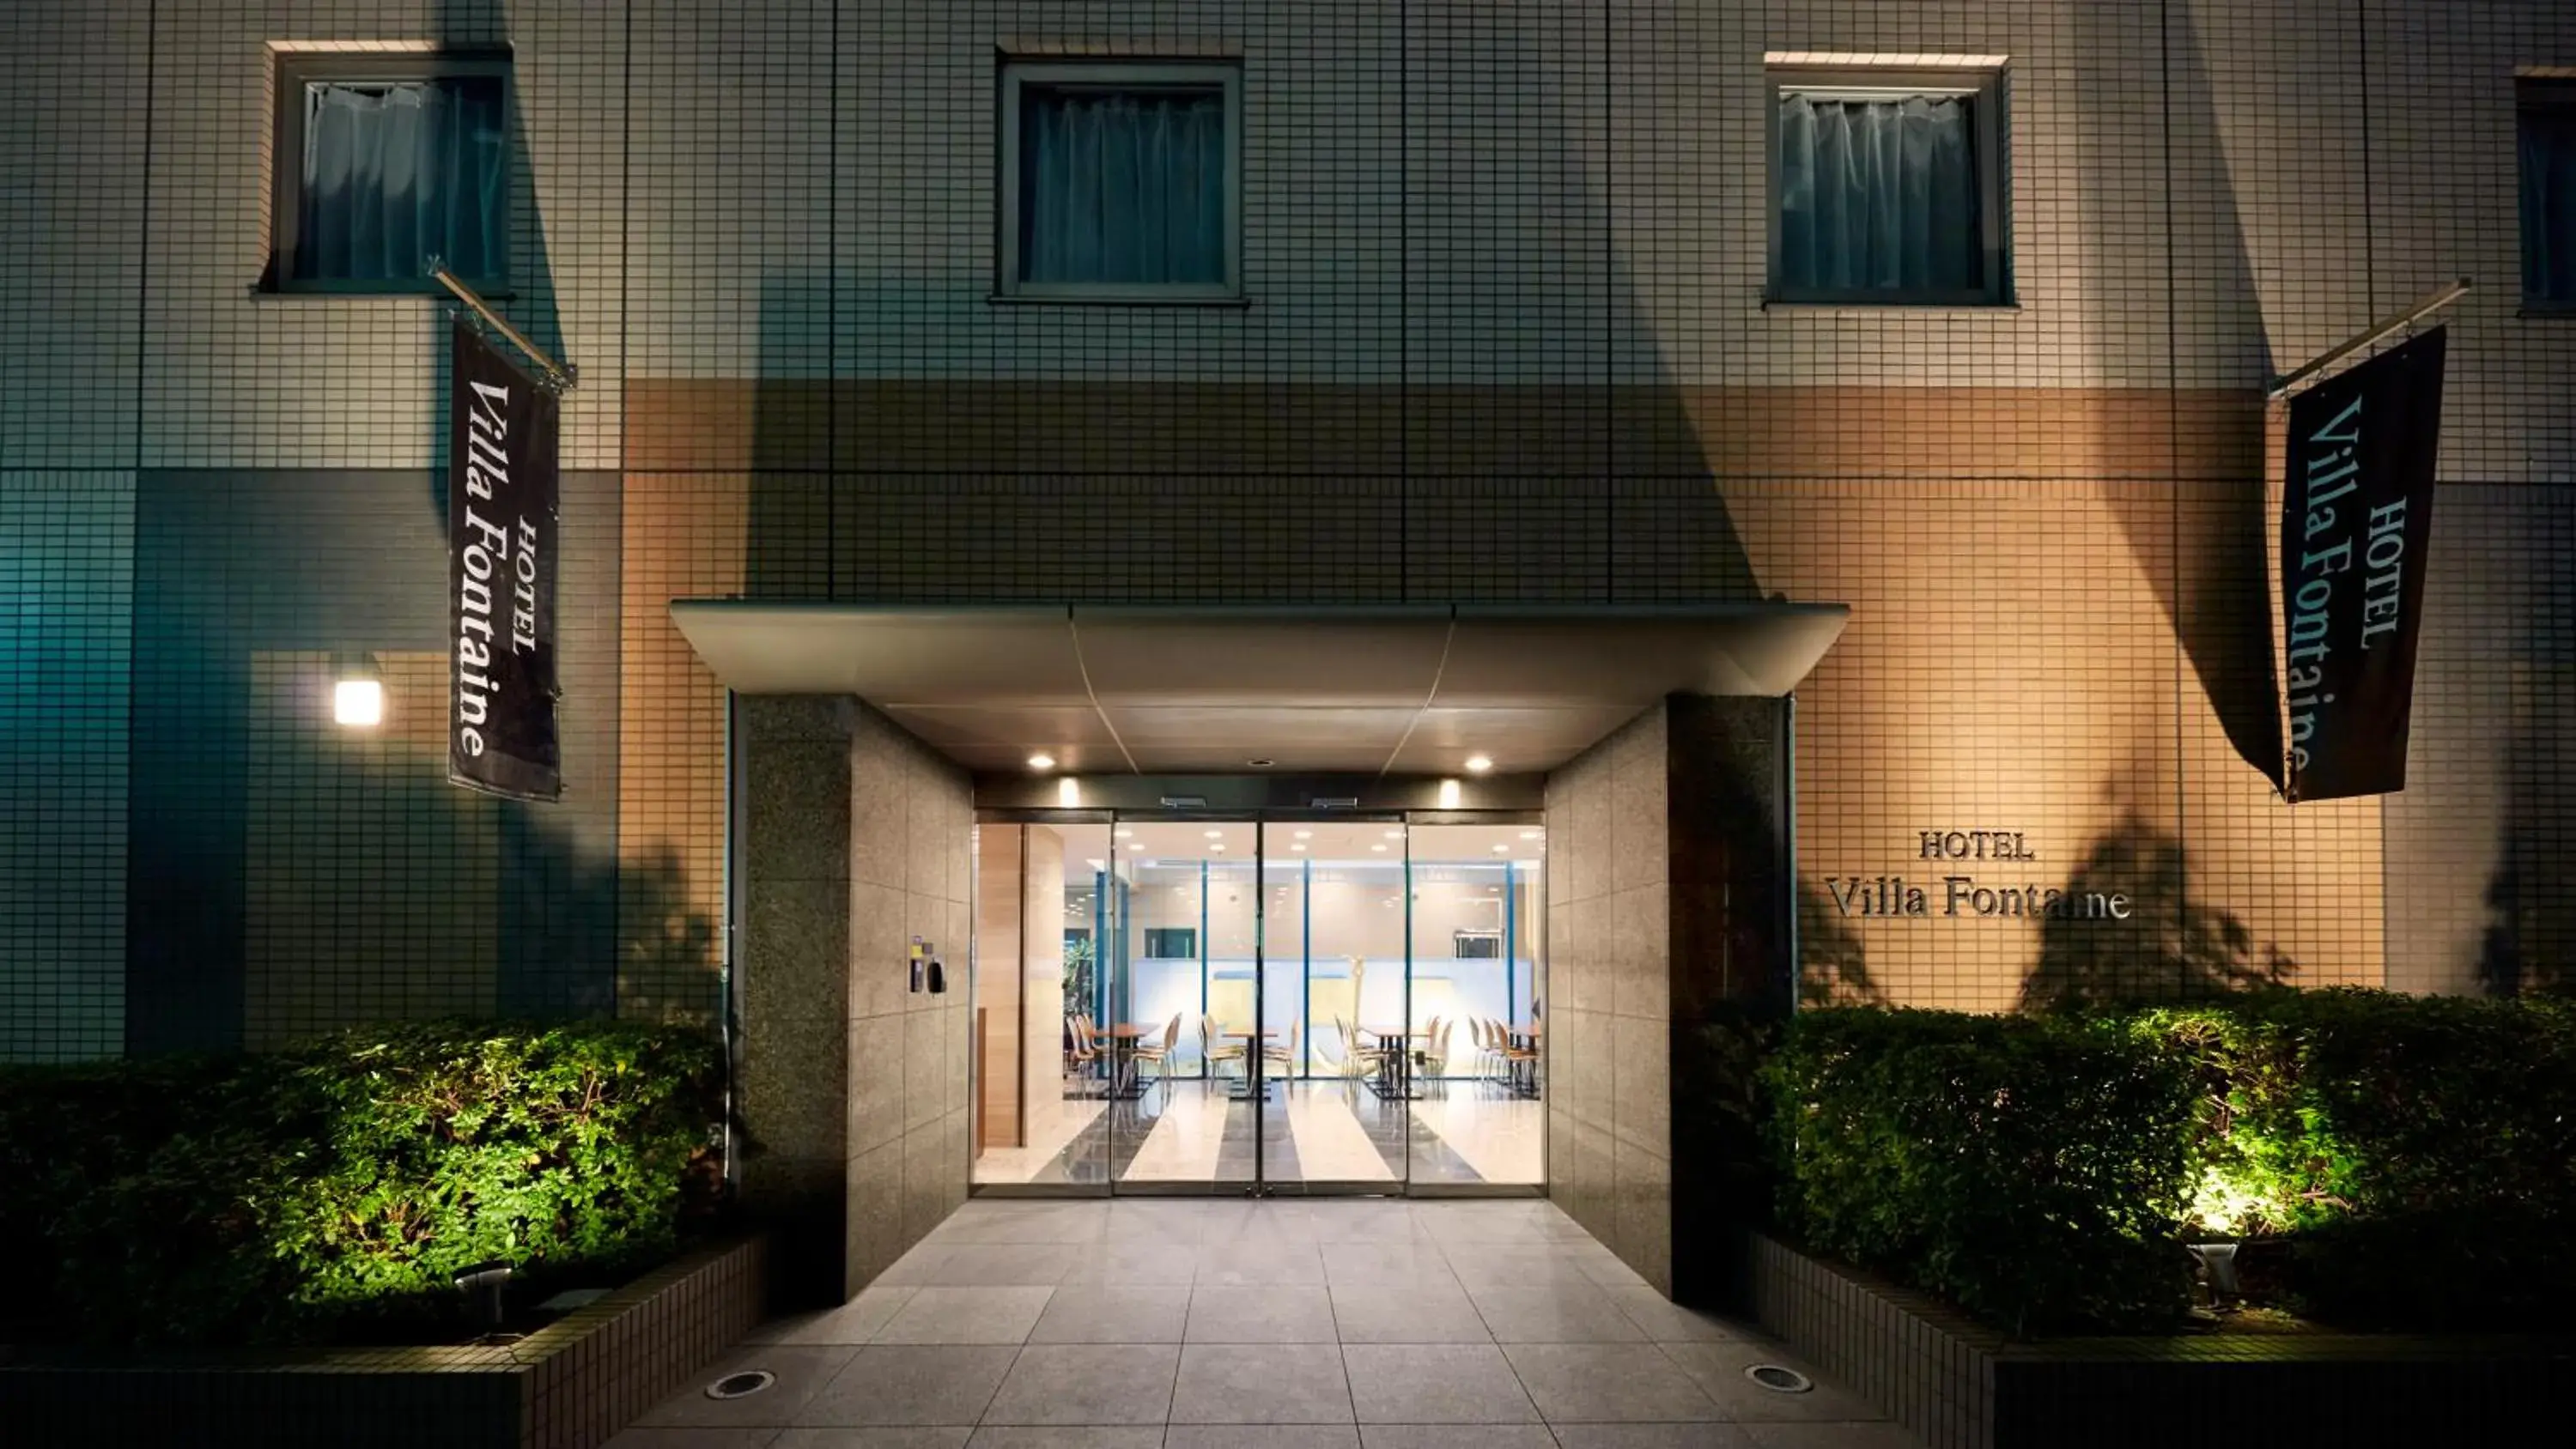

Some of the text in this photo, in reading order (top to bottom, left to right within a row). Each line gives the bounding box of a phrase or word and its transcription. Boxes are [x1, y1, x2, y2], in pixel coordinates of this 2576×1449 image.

[459, 380, 509, 757] Villa Fontaine
[513, 515, 537, 654] HOTEL
[2288, 395, 2362, 770] Villa Fontaine
[2360, 497, 2406, 650] HOTEL
[1826, 876, 2131, 919] Villa Fontaine
[1918, 831, 2035, 859] HOTEL
